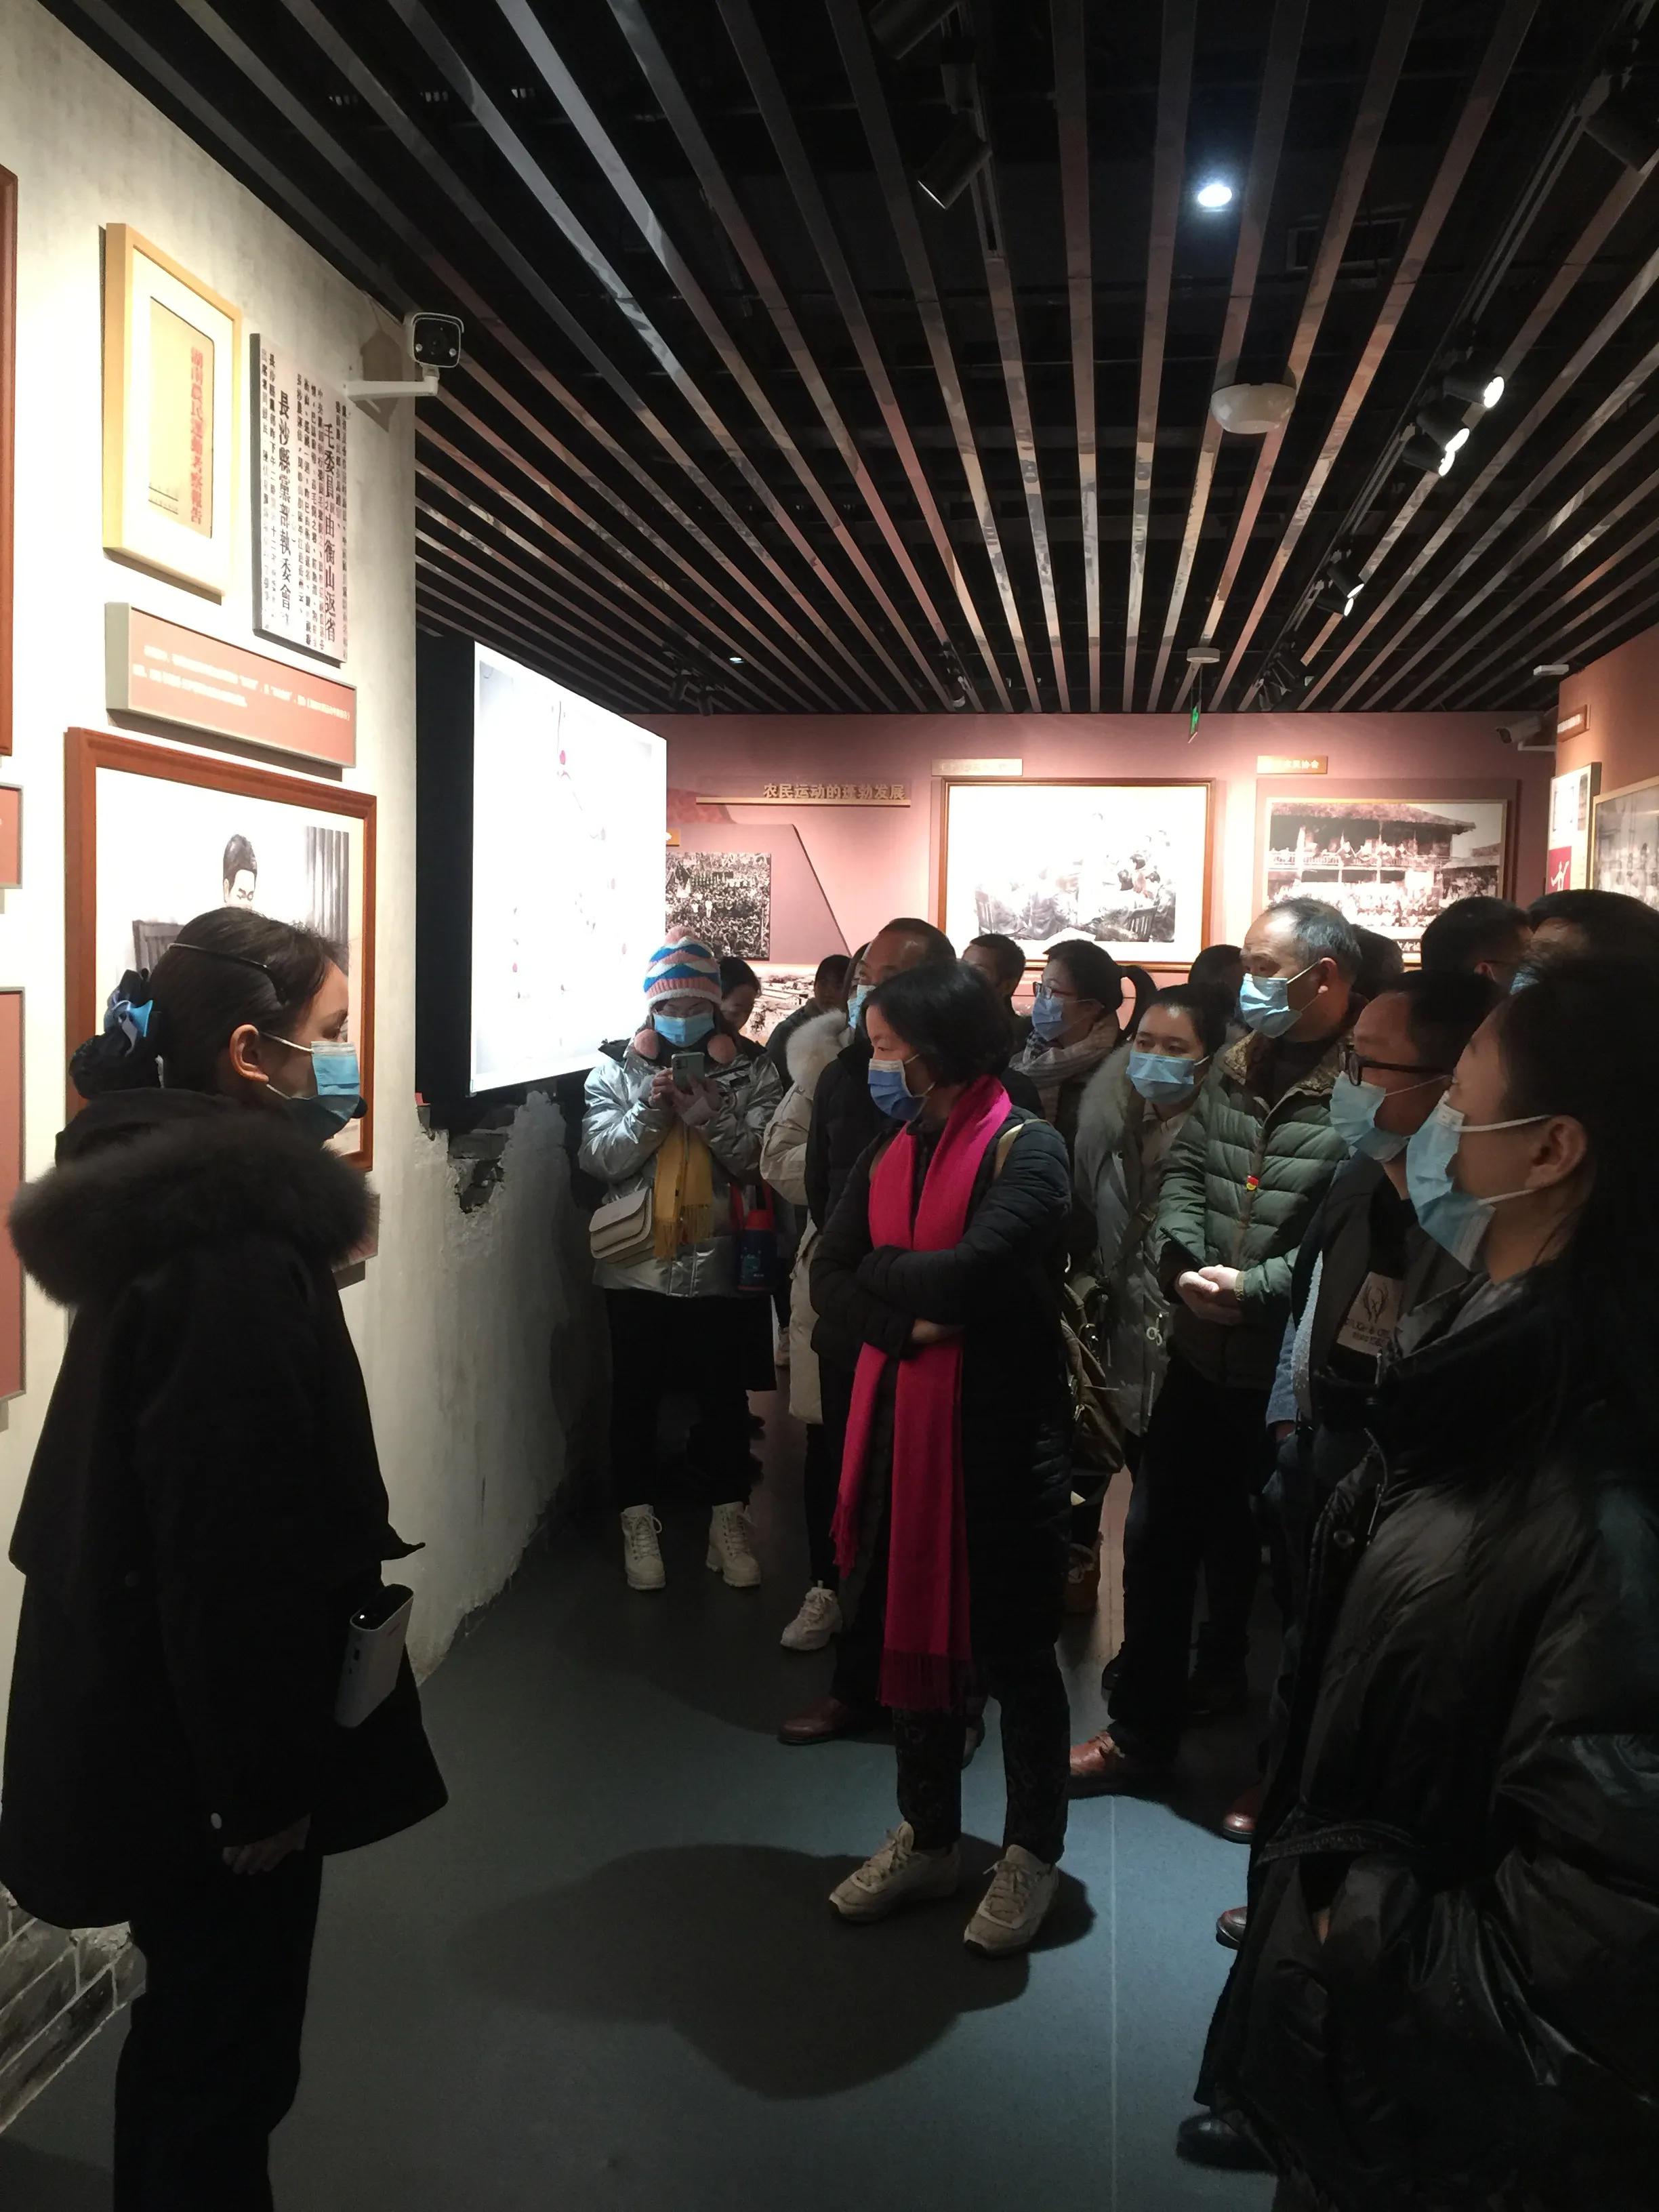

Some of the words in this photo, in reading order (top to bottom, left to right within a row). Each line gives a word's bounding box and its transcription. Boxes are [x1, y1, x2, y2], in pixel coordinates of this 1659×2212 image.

[763, 783, 905, 800] 农民运动的蓬勃发展
